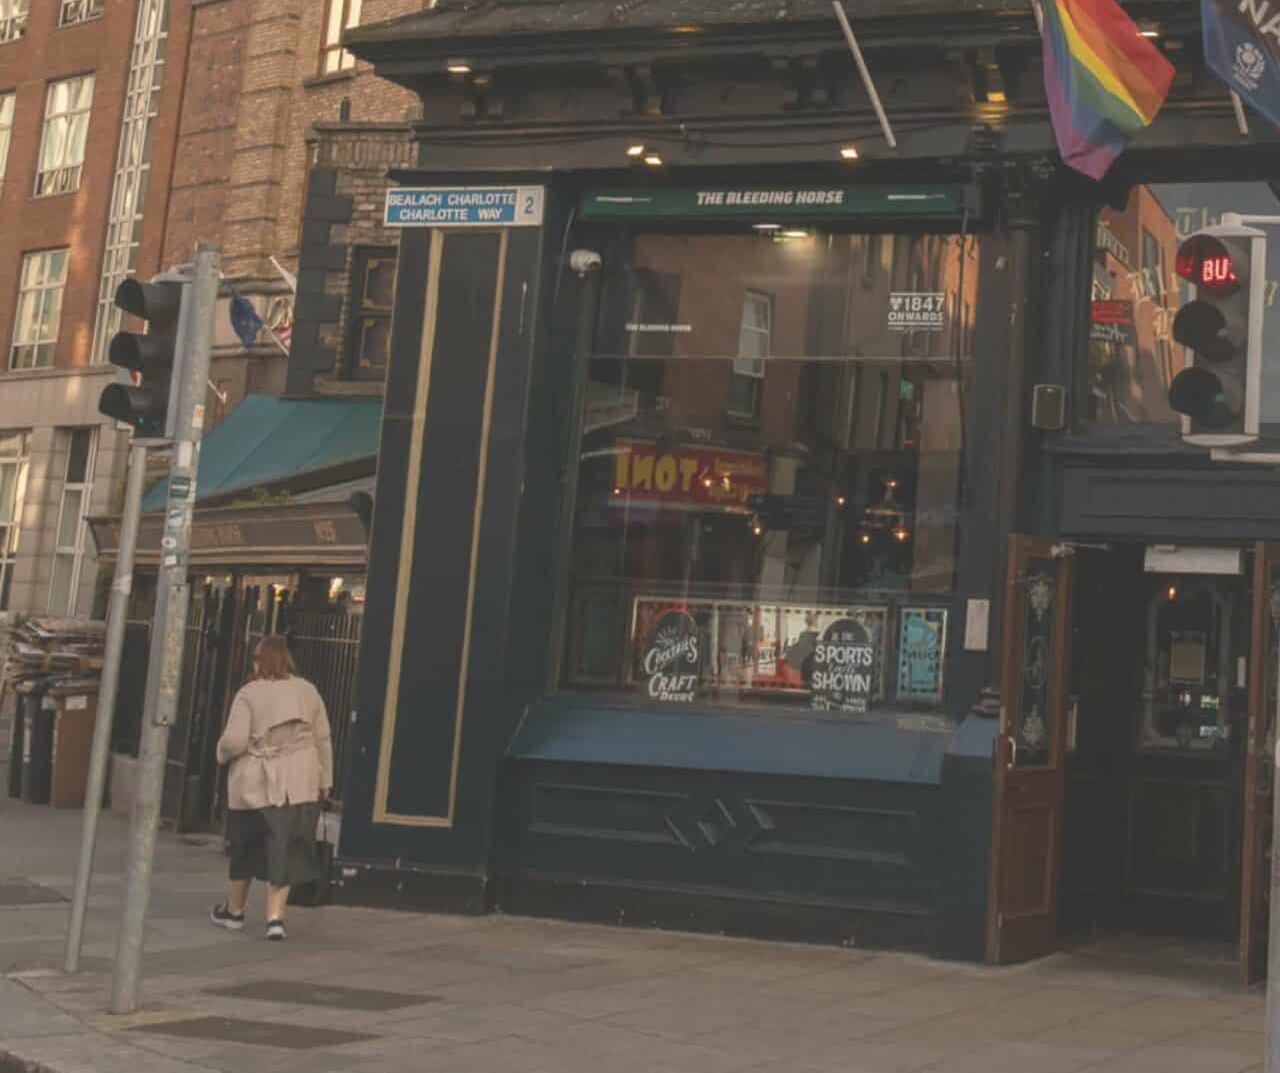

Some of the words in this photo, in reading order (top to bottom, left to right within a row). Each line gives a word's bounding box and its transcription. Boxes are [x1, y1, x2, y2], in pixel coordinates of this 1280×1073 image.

[389, 193, 442, 206] BEALACH
[447, 192, 515, 206] CHARLOTTE
[524, 196, 535, 214] 2
[697, 191, 724, 205] THE
[726, 191, 793, 205] BLEEDING
[796, 190, 844, 204] HORSE
[400, 207, 469, 220] CHARLOTTE
[477, 207, 503, 220] WAY
[1203, 258, 1235, 281] BU
[904, 296, 945, 312] 1847
[888, 311, 943, 321] ONWARDS
[815, 644, 873, 666] SPORTS
[648, 671, 697, 697] CRAFT
[811, 671, 871, 693] SHOWN
